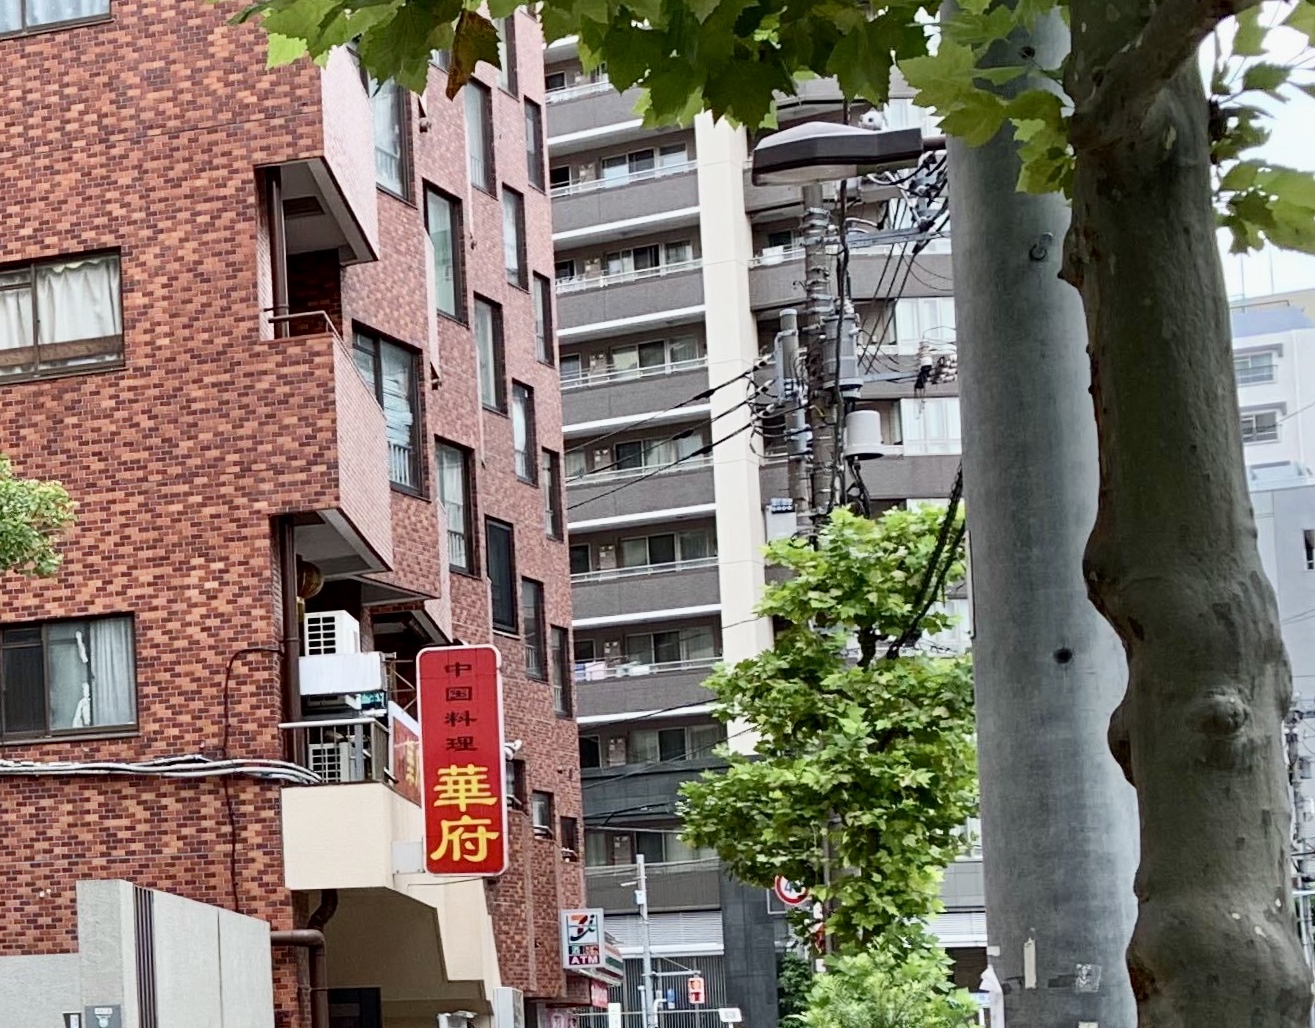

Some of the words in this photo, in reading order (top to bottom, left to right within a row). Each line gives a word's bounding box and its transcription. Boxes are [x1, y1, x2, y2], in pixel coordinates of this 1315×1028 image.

[444, 661, 478, 752] 中国料理
[430, 764, 499, 864] 華府
[570, 956, 598, 965] ATM
